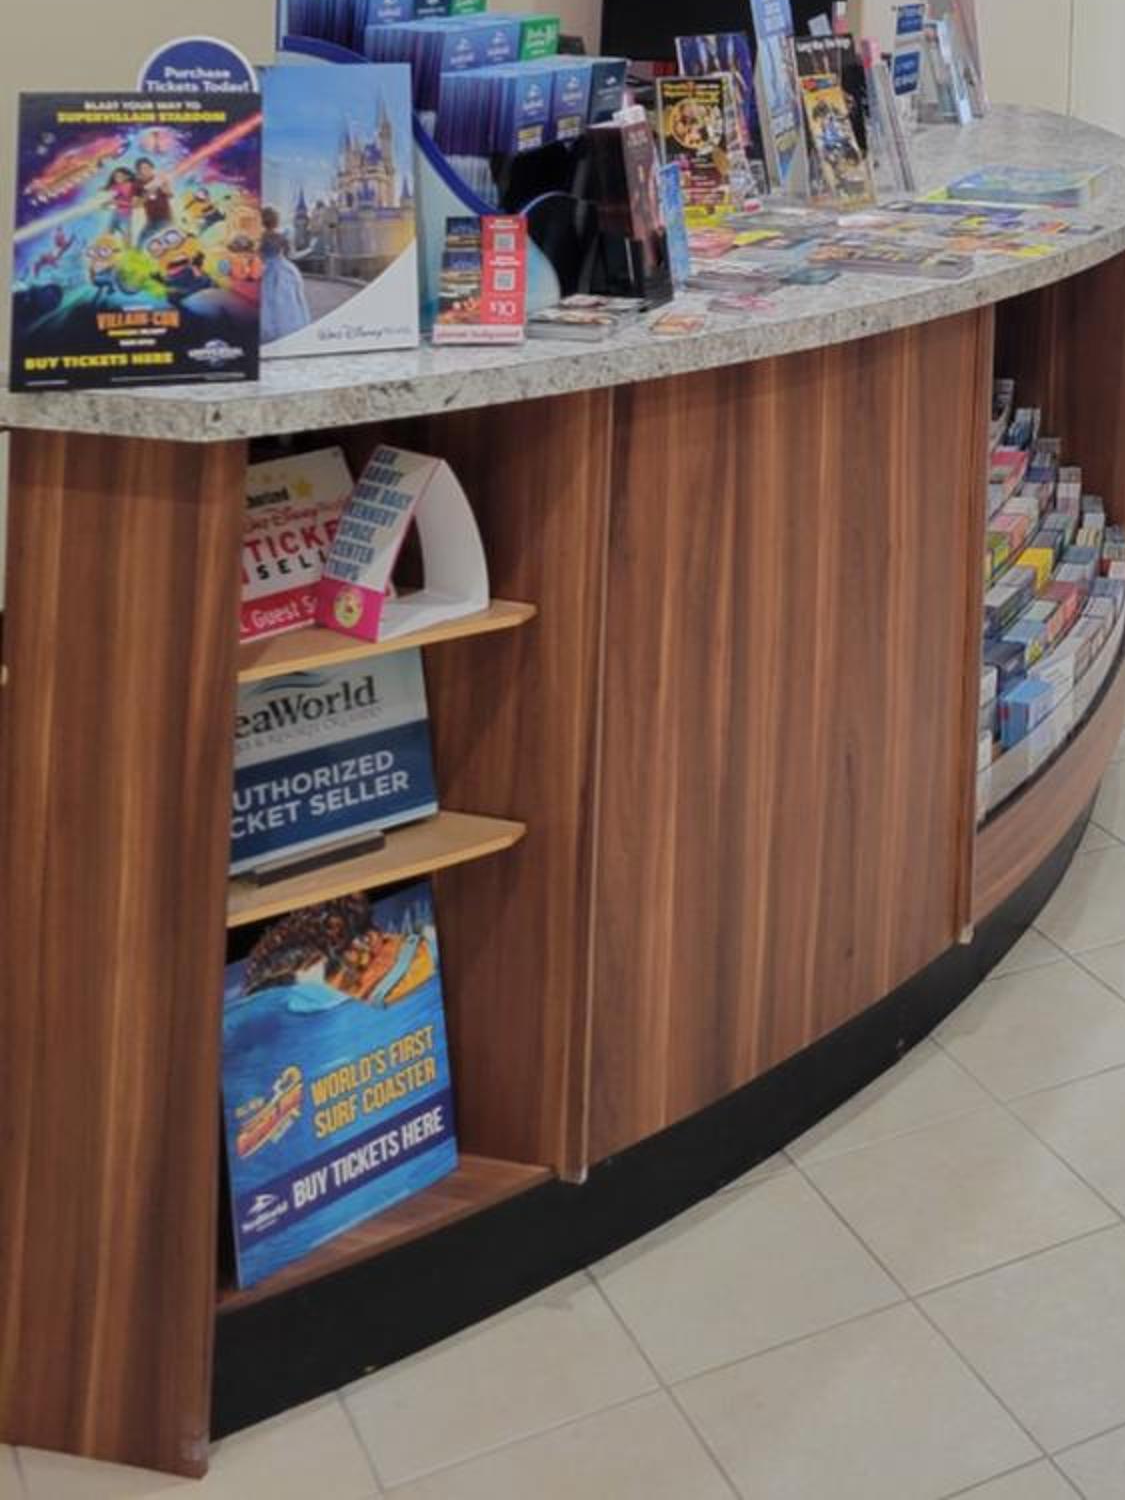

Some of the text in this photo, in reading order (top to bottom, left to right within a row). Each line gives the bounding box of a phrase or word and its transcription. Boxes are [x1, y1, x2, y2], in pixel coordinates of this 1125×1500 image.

[145, 79, 250, 93] Tickets Today!
[163, 66, 231, 80] Purchase
[24, 352, 174, 372] BUY TICKETS HERE
[364, 465, 404, 487] ABOUT
[339, 520, 377, 543] SPACE
[333, 539, 375, 564] CENTER
[251, 602, 300, 630] Guest
[234, 674, 379, 740] eaWorld
[233, 749, 395, 813] UTHORIZED
[230, 770, 410, 840] CKET SELLER
[310, 1025, 434, 1107] WORLD'S FIRST
[314, 1094, 357, 1140] SURF
[361, 1056, 437, 1114] COASTER
[292, 1105, 445, 1209] BUY TICKETS HERE
